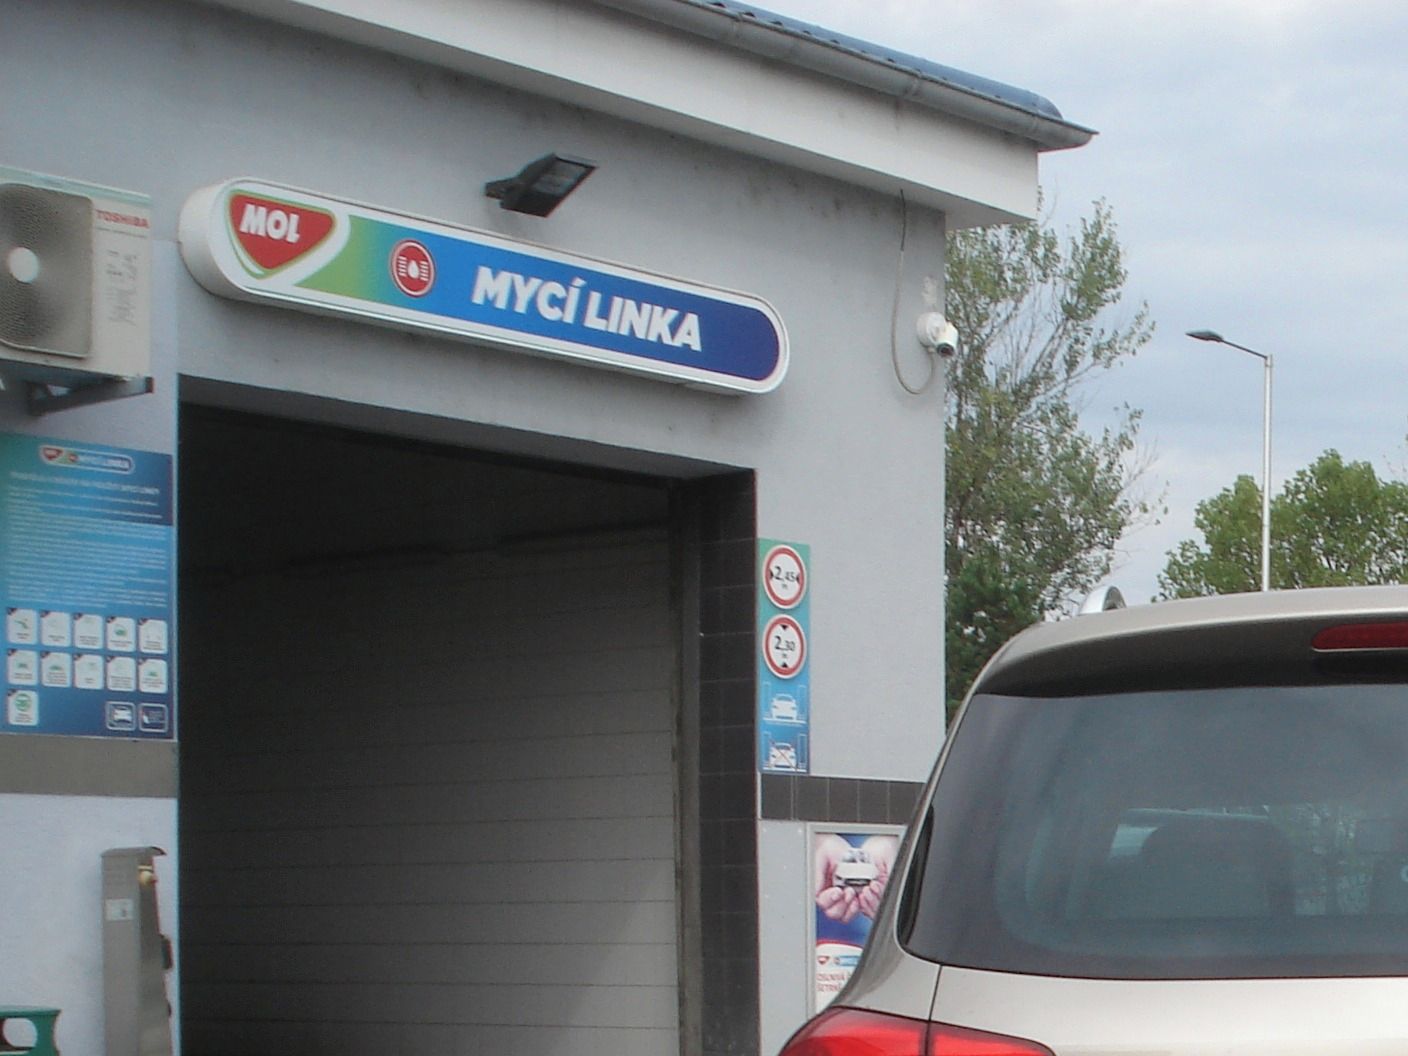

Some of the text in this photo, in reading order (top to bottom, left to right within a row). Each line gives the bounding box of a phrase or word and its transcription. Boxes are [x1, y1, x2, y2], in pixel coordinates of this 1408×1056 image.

[95, 208, 150, 229] TOSHIBA
[240, 203, 300, 244] MOL
[471, 265, 702, 352] MYCÍ LINKA
